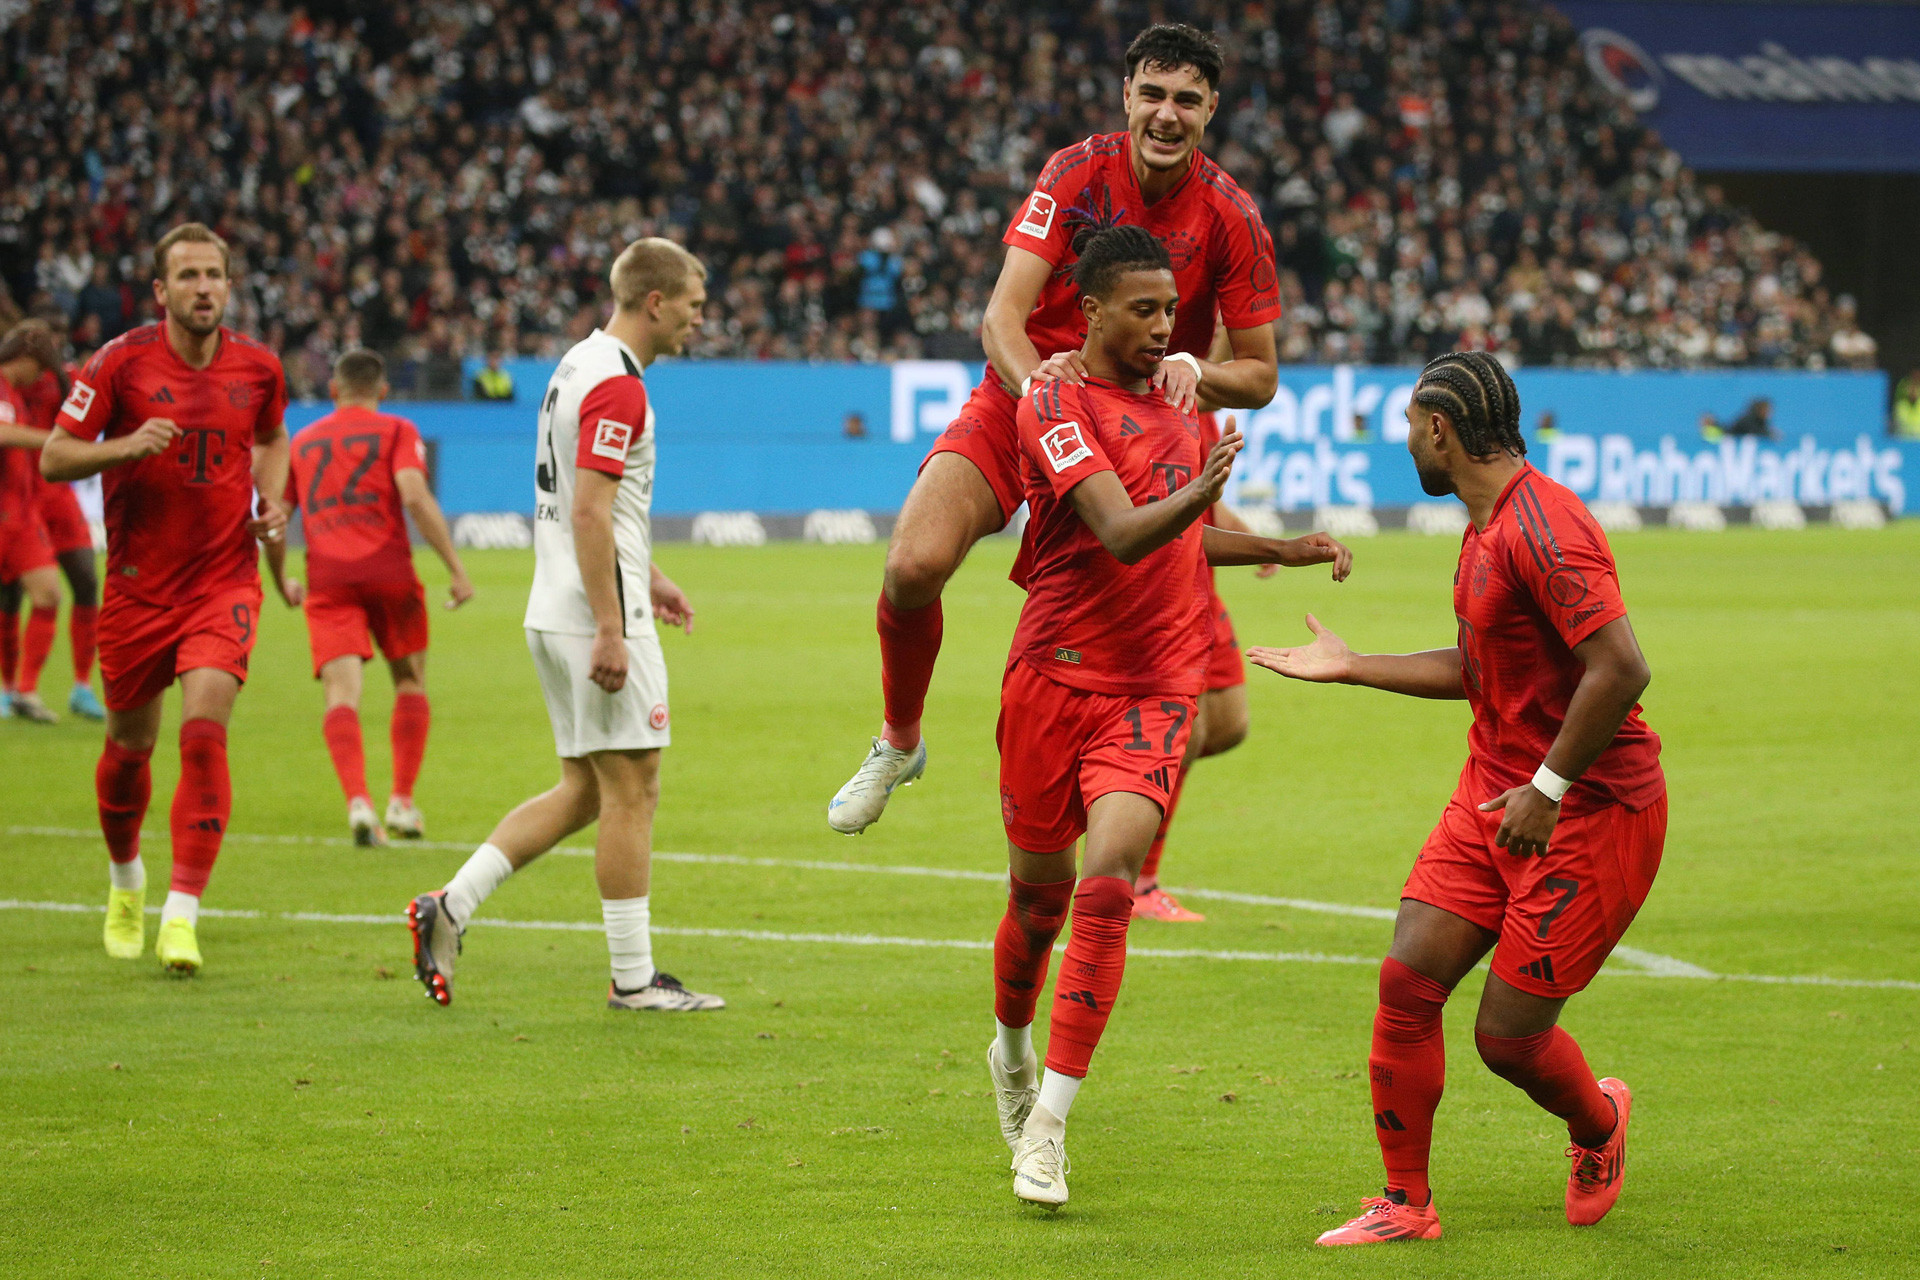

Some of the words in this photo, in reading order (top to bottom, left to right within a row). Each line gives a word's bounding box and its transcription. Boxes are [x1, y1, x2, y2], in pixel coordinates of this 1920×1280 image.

[300, 433, 380, 515] 22
[232, 604, 251, 643] 9
[1123, 701, 1188, 755] 17
[1537, 876, 1579, 939] 7
